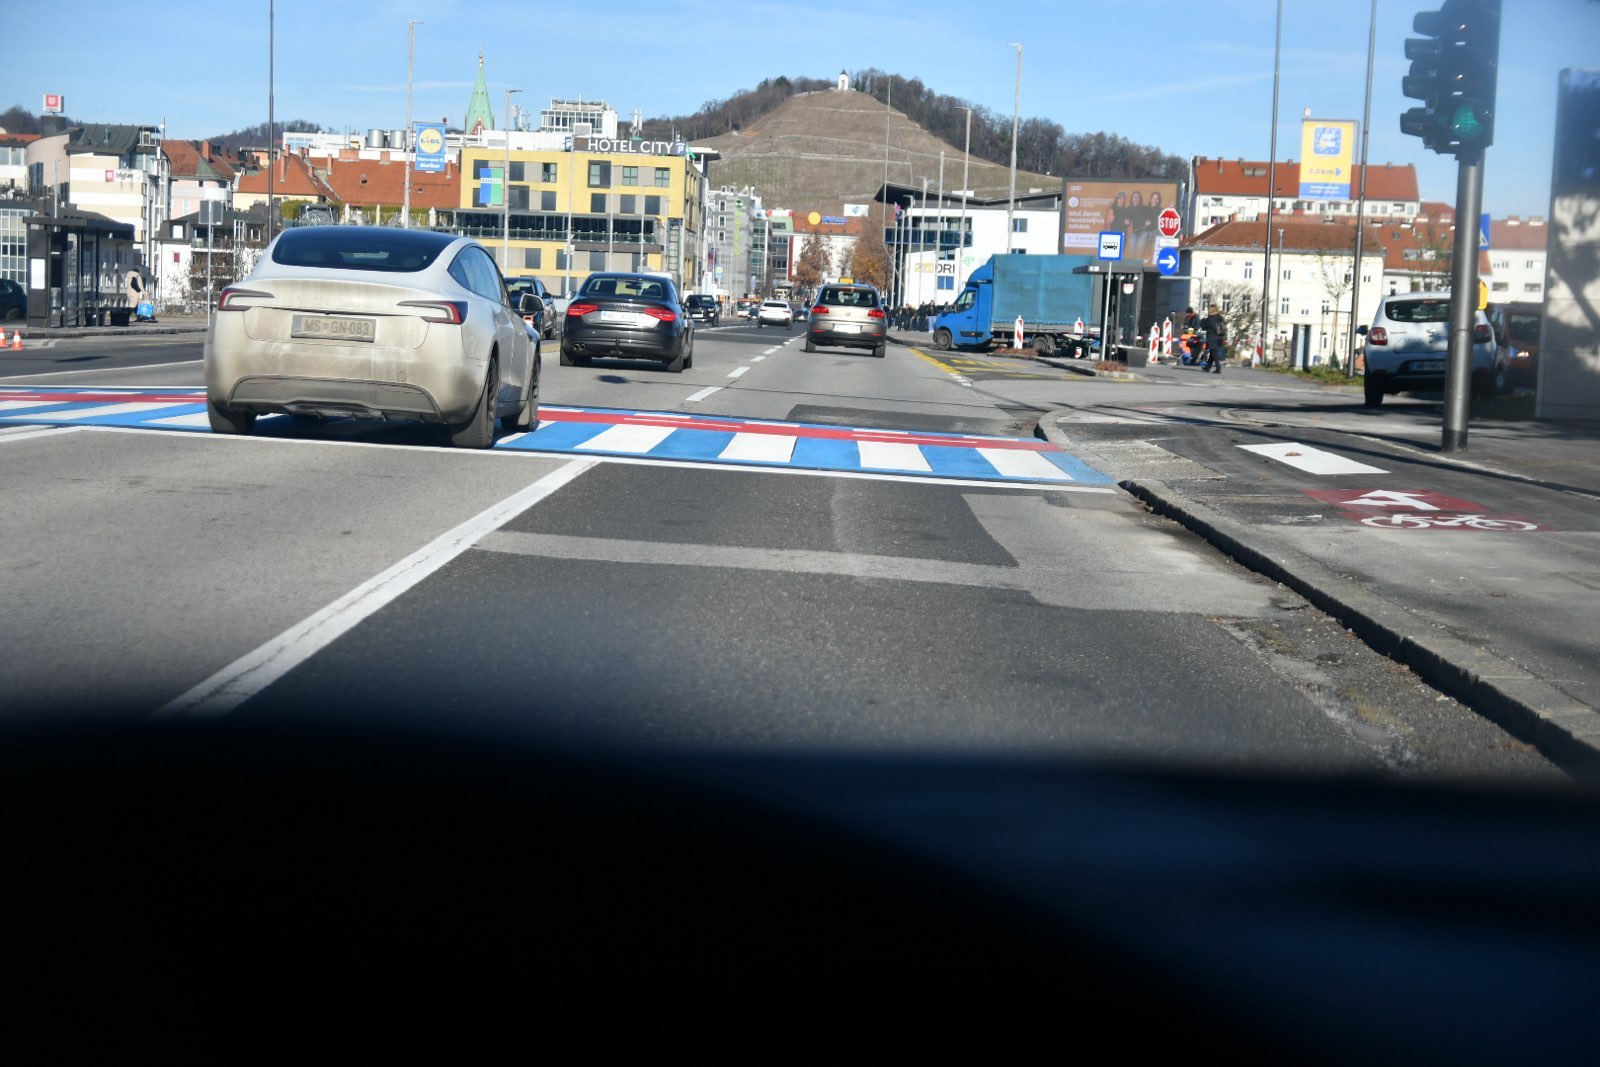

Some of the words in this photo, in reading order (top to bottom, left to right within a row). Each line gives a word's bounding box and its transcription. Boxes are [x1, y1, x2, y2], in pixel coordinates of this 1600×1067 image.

[588, 139, 636, 152] HOTEL
[640, 141, 673, 154] CITY
[1160, 217, 1179, 229] STOP
[304, 319, 321, 332] MS
